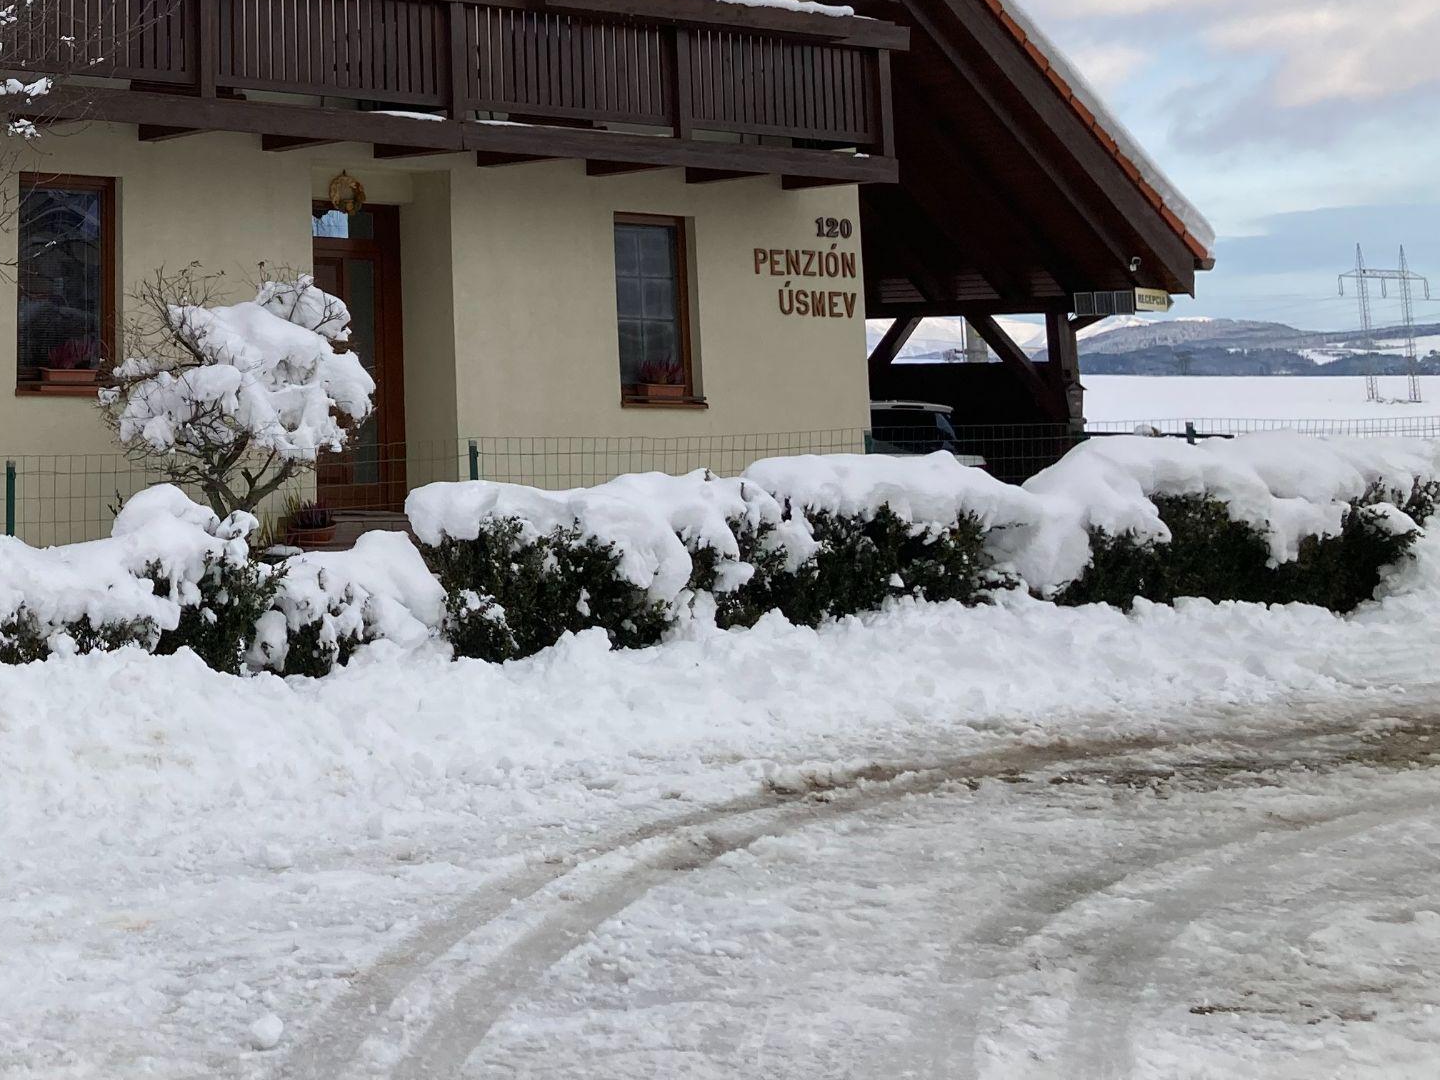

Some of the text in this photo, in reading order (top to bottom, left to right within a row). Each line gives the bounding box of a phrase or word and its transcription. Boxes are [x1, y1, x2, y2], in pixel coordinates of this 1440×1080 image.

[815, 217, 853, 239] 120
[753, 243, 857, 279] PENZIÓN
[778, 281, 857, 319] ÚSMEV
